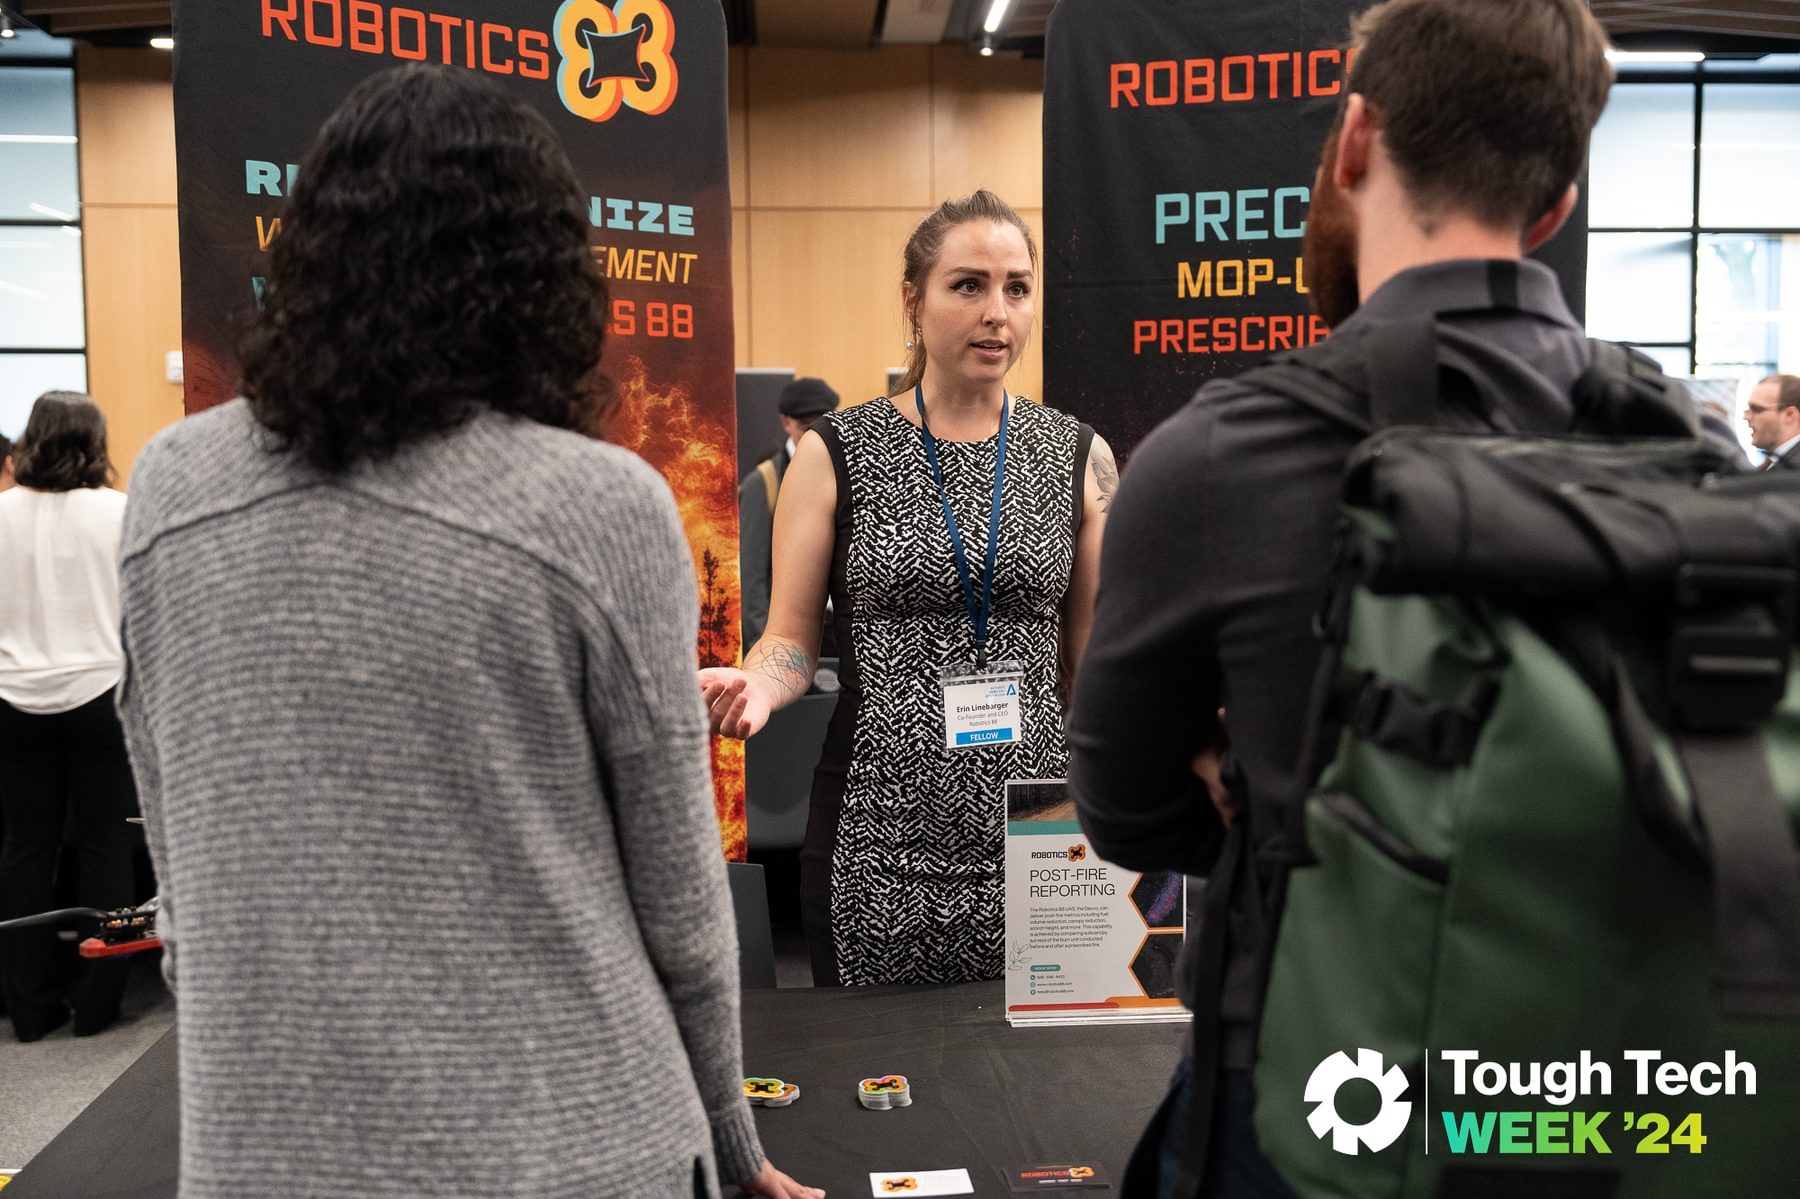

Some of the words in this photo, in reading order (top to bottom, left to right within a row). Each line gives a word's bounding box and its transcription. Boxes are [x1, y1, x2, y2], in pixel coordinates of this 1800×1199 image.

[262, 0, 549, 80] ROBOTICS
[1110, 48, 1357, 109] ROBOTIC
[646, 302, 693, 339] 88
[956, 705, 970, 713] Erin
[971, 702, 1009, 712] Linebarger
[970, 732, 999, 742] FELLOW
[1031, 851, 1068, 859] ROBOTICS
[1030, 868, 1107, 882] POST-FIRE
[1030, 884, 1115, 898] REPORTING
